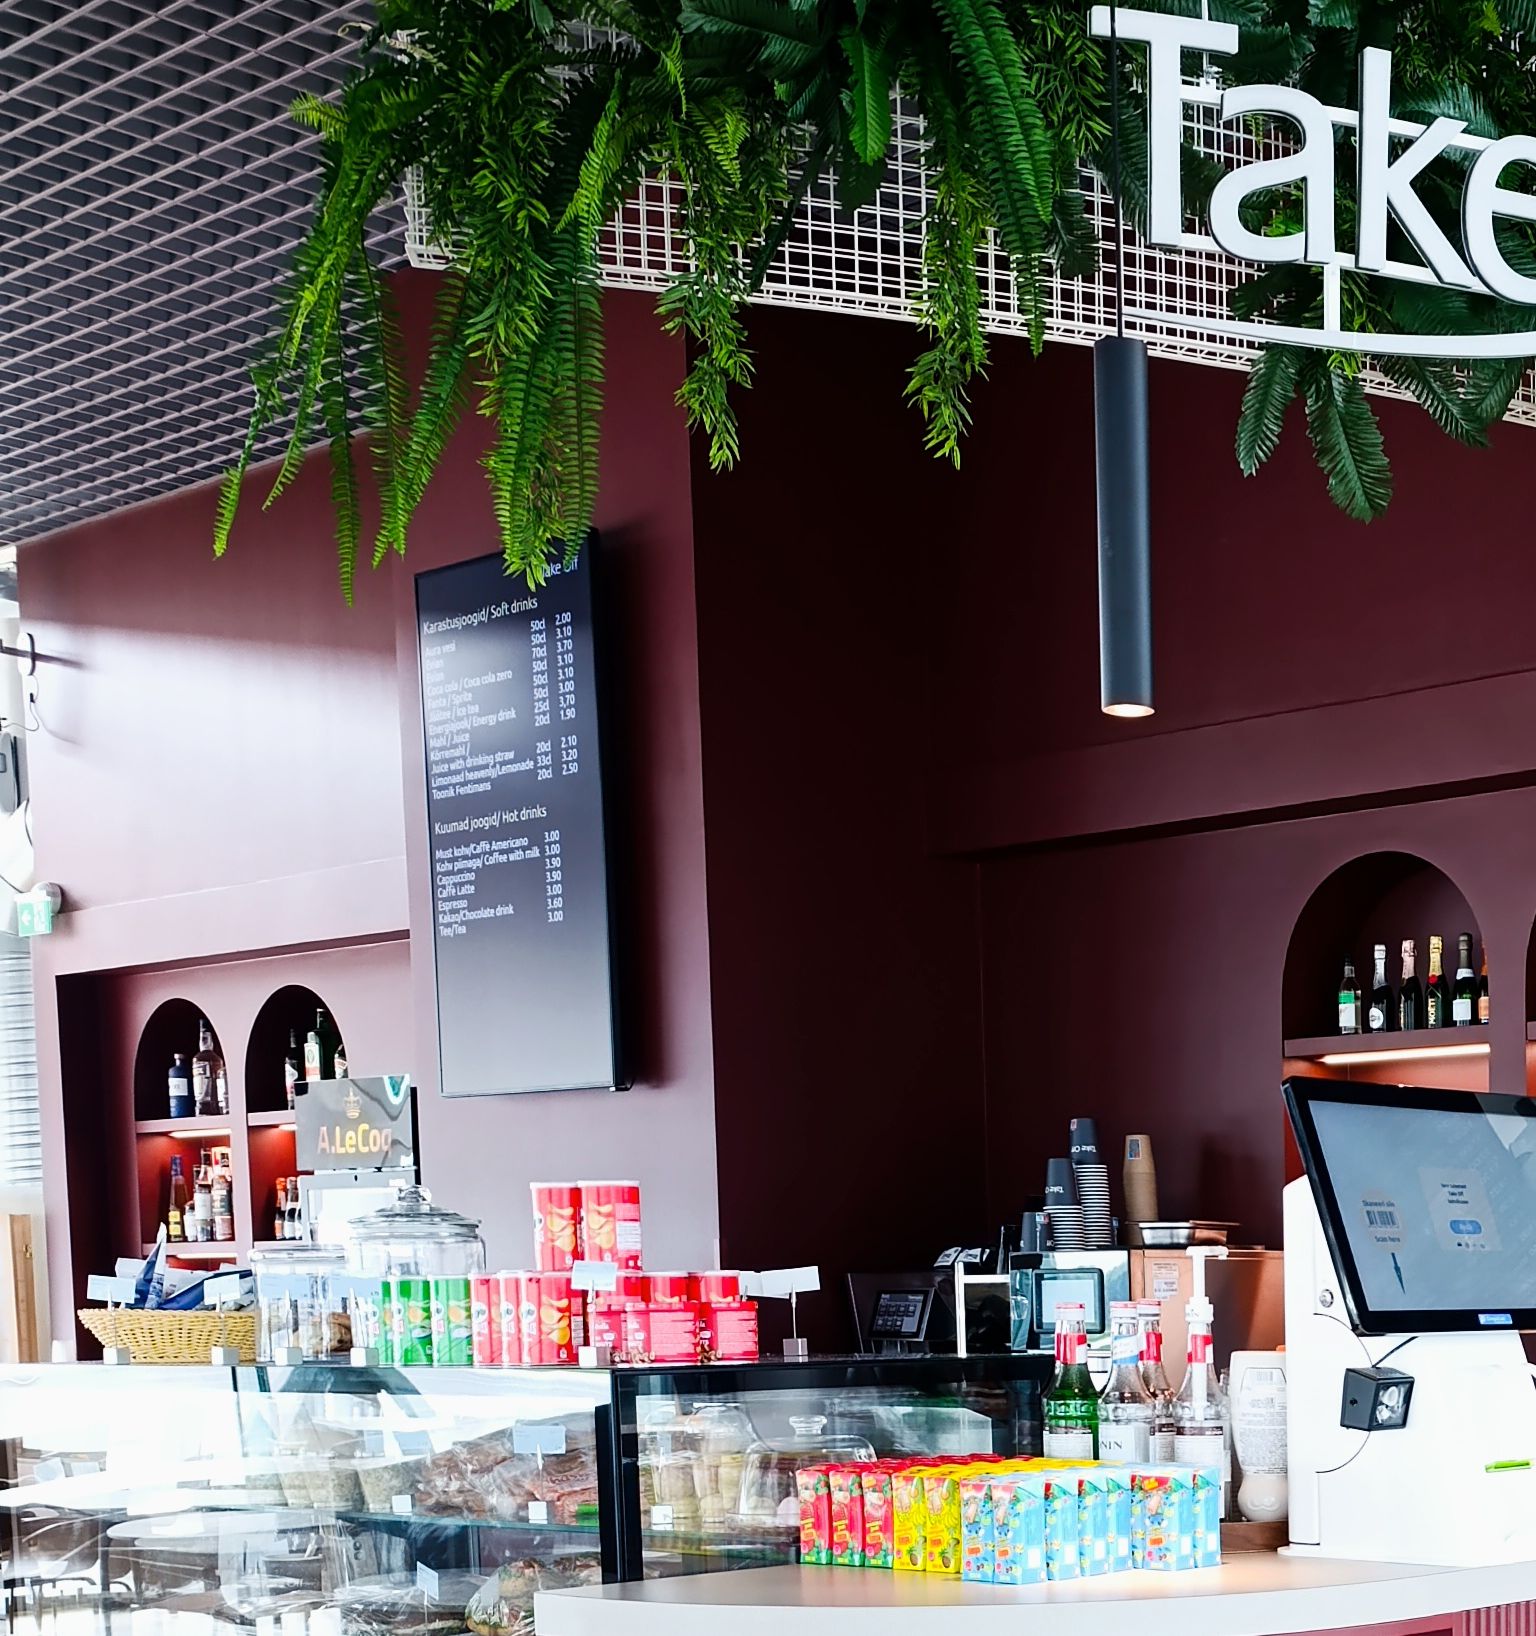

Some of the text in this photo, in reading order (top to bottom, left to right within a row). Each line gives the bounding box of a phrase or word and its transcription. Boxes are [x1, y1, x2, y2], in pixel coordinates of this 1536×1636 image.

[423, 595, 538, 635] Karastusjoogid/ Soft drinks
[530, 618, 546, 632] 50cl
[555, 611, 572, 626] 2.00
[531, 625, 572, 645] 50cl 3.10
[531, 639, 573, 659] 70cl 3.70
[464, 676, 481, 688] Coca
[481, 672, 496, 685] cola
[496, 670, 513, 681] zero
[532, 658, 548, 673] 50cl
[557, 653, 574, 667] 3.10
[533, 671, 549, 686] 50cl
[558, 666, 574, 680] 3.10
[467, 703, 480, 714] tea
[533, 685, 549, 700] 50cl
[558, 680, 575, 694] 3.00
[472, 713, 497, 727] Energy
[497, 706, 516, 721] drink
[533, 698, 550, 714] 25cl
[534, 712, 551, 727] 20cl
[560, 707, 576, 721] 1.90
[431, 734, 577, 775] Juice with drinking straw 20cl 2.10
[431, 771, 465, 788] Limonaad
[536, 753, 552, 767] 33cl
[561, 748, 578, 762] 3.20
[432, 762, 579, 801] Toonik Fentimans 20cl 2.50
[434, 804, 547, 835] Kuumad joogid/ Hot drinks
[435, 848, 453, 860] Must
[491, 836, 529, 851] Americano
[544, 830, 560, 843] 3.00
[436, 861, 453, 873] Kohv
[484, 853, 508, 866] Coffee
[508, 849, 525, 861] with
[525, 846, 541, 859] milk
[544, 843, 560, 856] 3.00
[436, 857, 561, 888] Cappuccino 3.90
[457, 884, 475, 895] Latte
[546, 870, 562, 883] 3.90
[438, 883, 562, 913] Espresso 3.00
[495, 903, 514, 917] drink
[547, 897, 563, 910] 3.60
[439, 910, 564, 938] Tee/Tea 3.00
[317, 1123, 392, 1158] A.LeCoq
